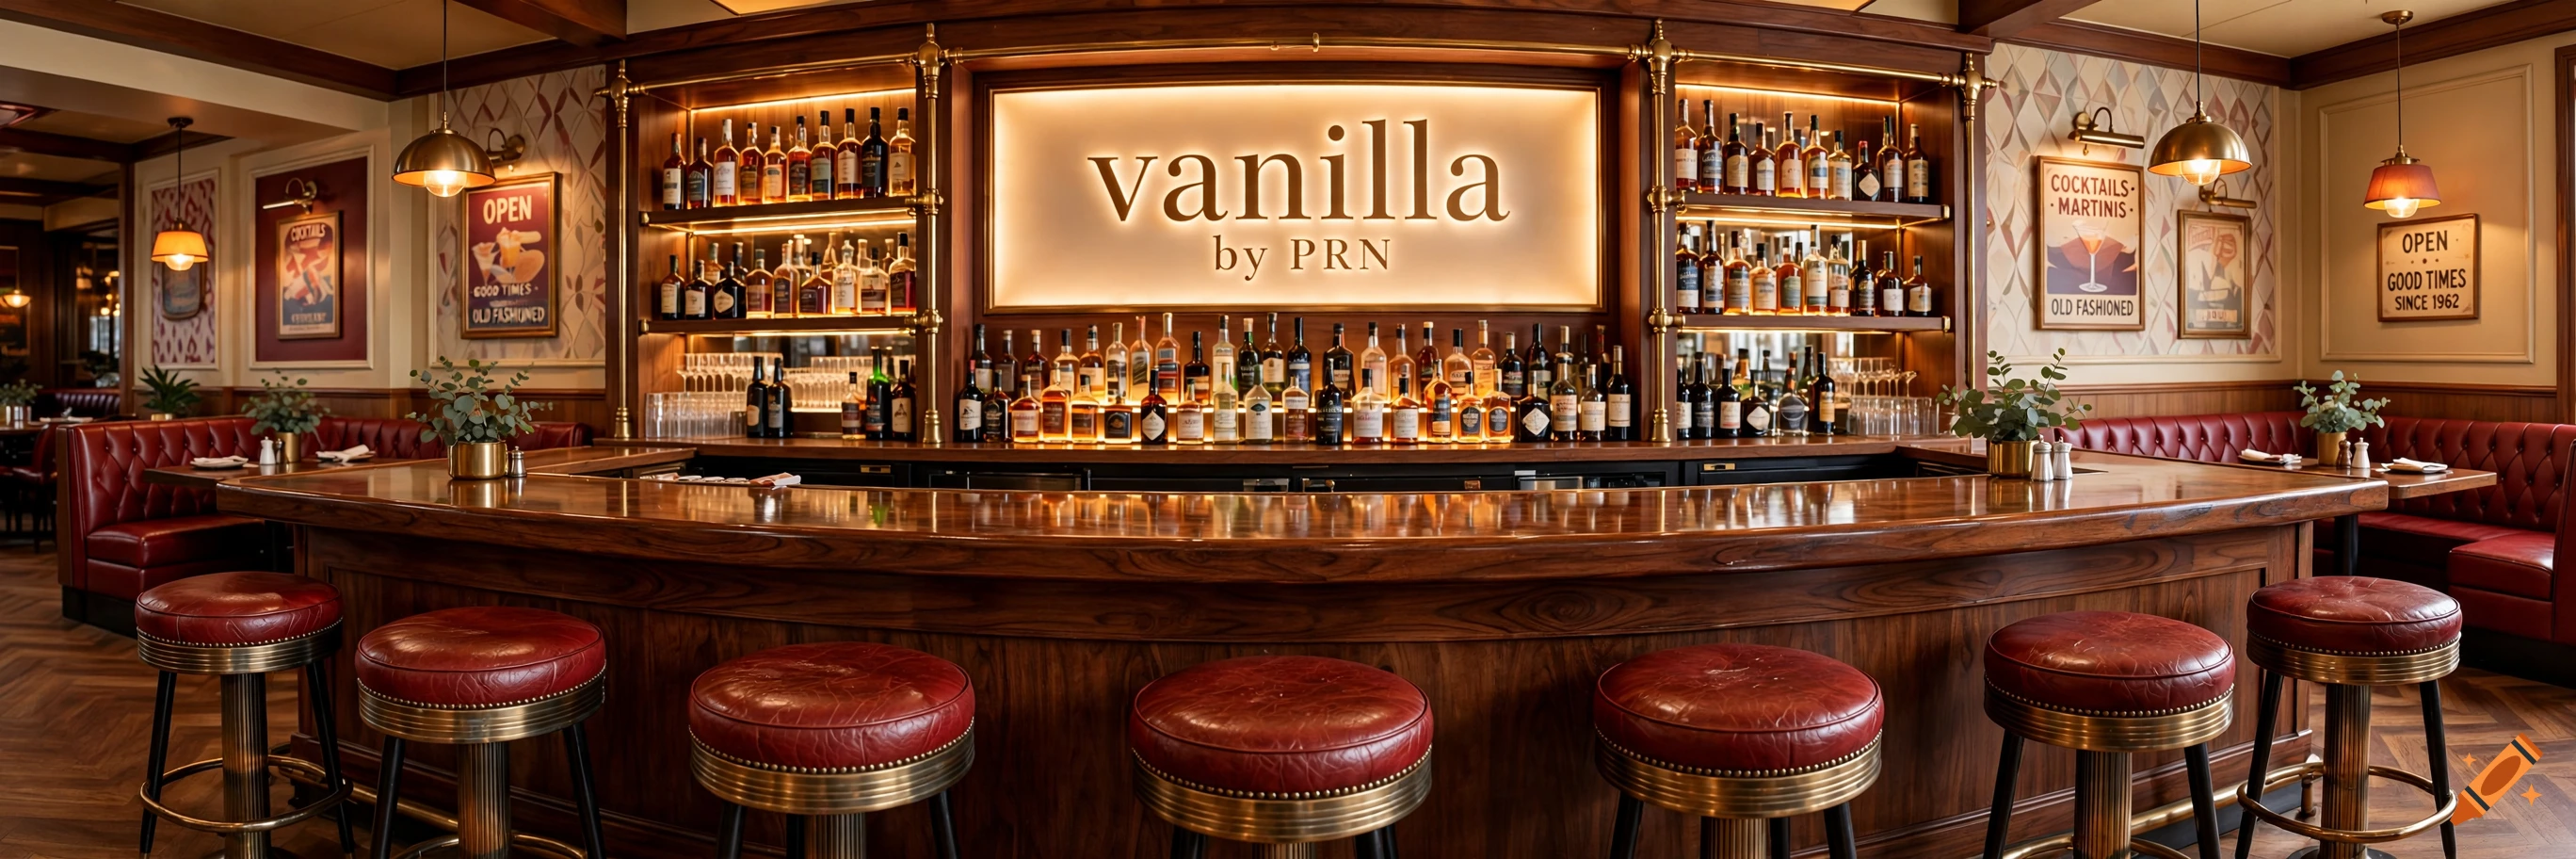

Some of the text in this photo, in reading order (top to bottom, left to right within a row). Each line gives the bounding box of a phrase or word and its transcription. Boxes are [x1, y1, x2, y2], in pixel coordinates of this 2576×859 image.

[1087, 119, 1510, 222] vanilla
[2051, 174, 2129, 197] COCKTAILS
[483, 195, 532, 224] OPEN
[2058, 197, 2127, 219] MARTINIS
[2402, 230, 2448, 253] OPEN
[1213, 235, 1392, 281] by PRN
[474, 283, 532, 298] GOOD TIMES
[2388, 268, 2467, 292] GOOD TIMES
[2052, 299, 2133, 316] OLD FASHIONED
[2395, 293, 2459, 311] SINCE 1962
[473, 308, 491, 324] OLD
